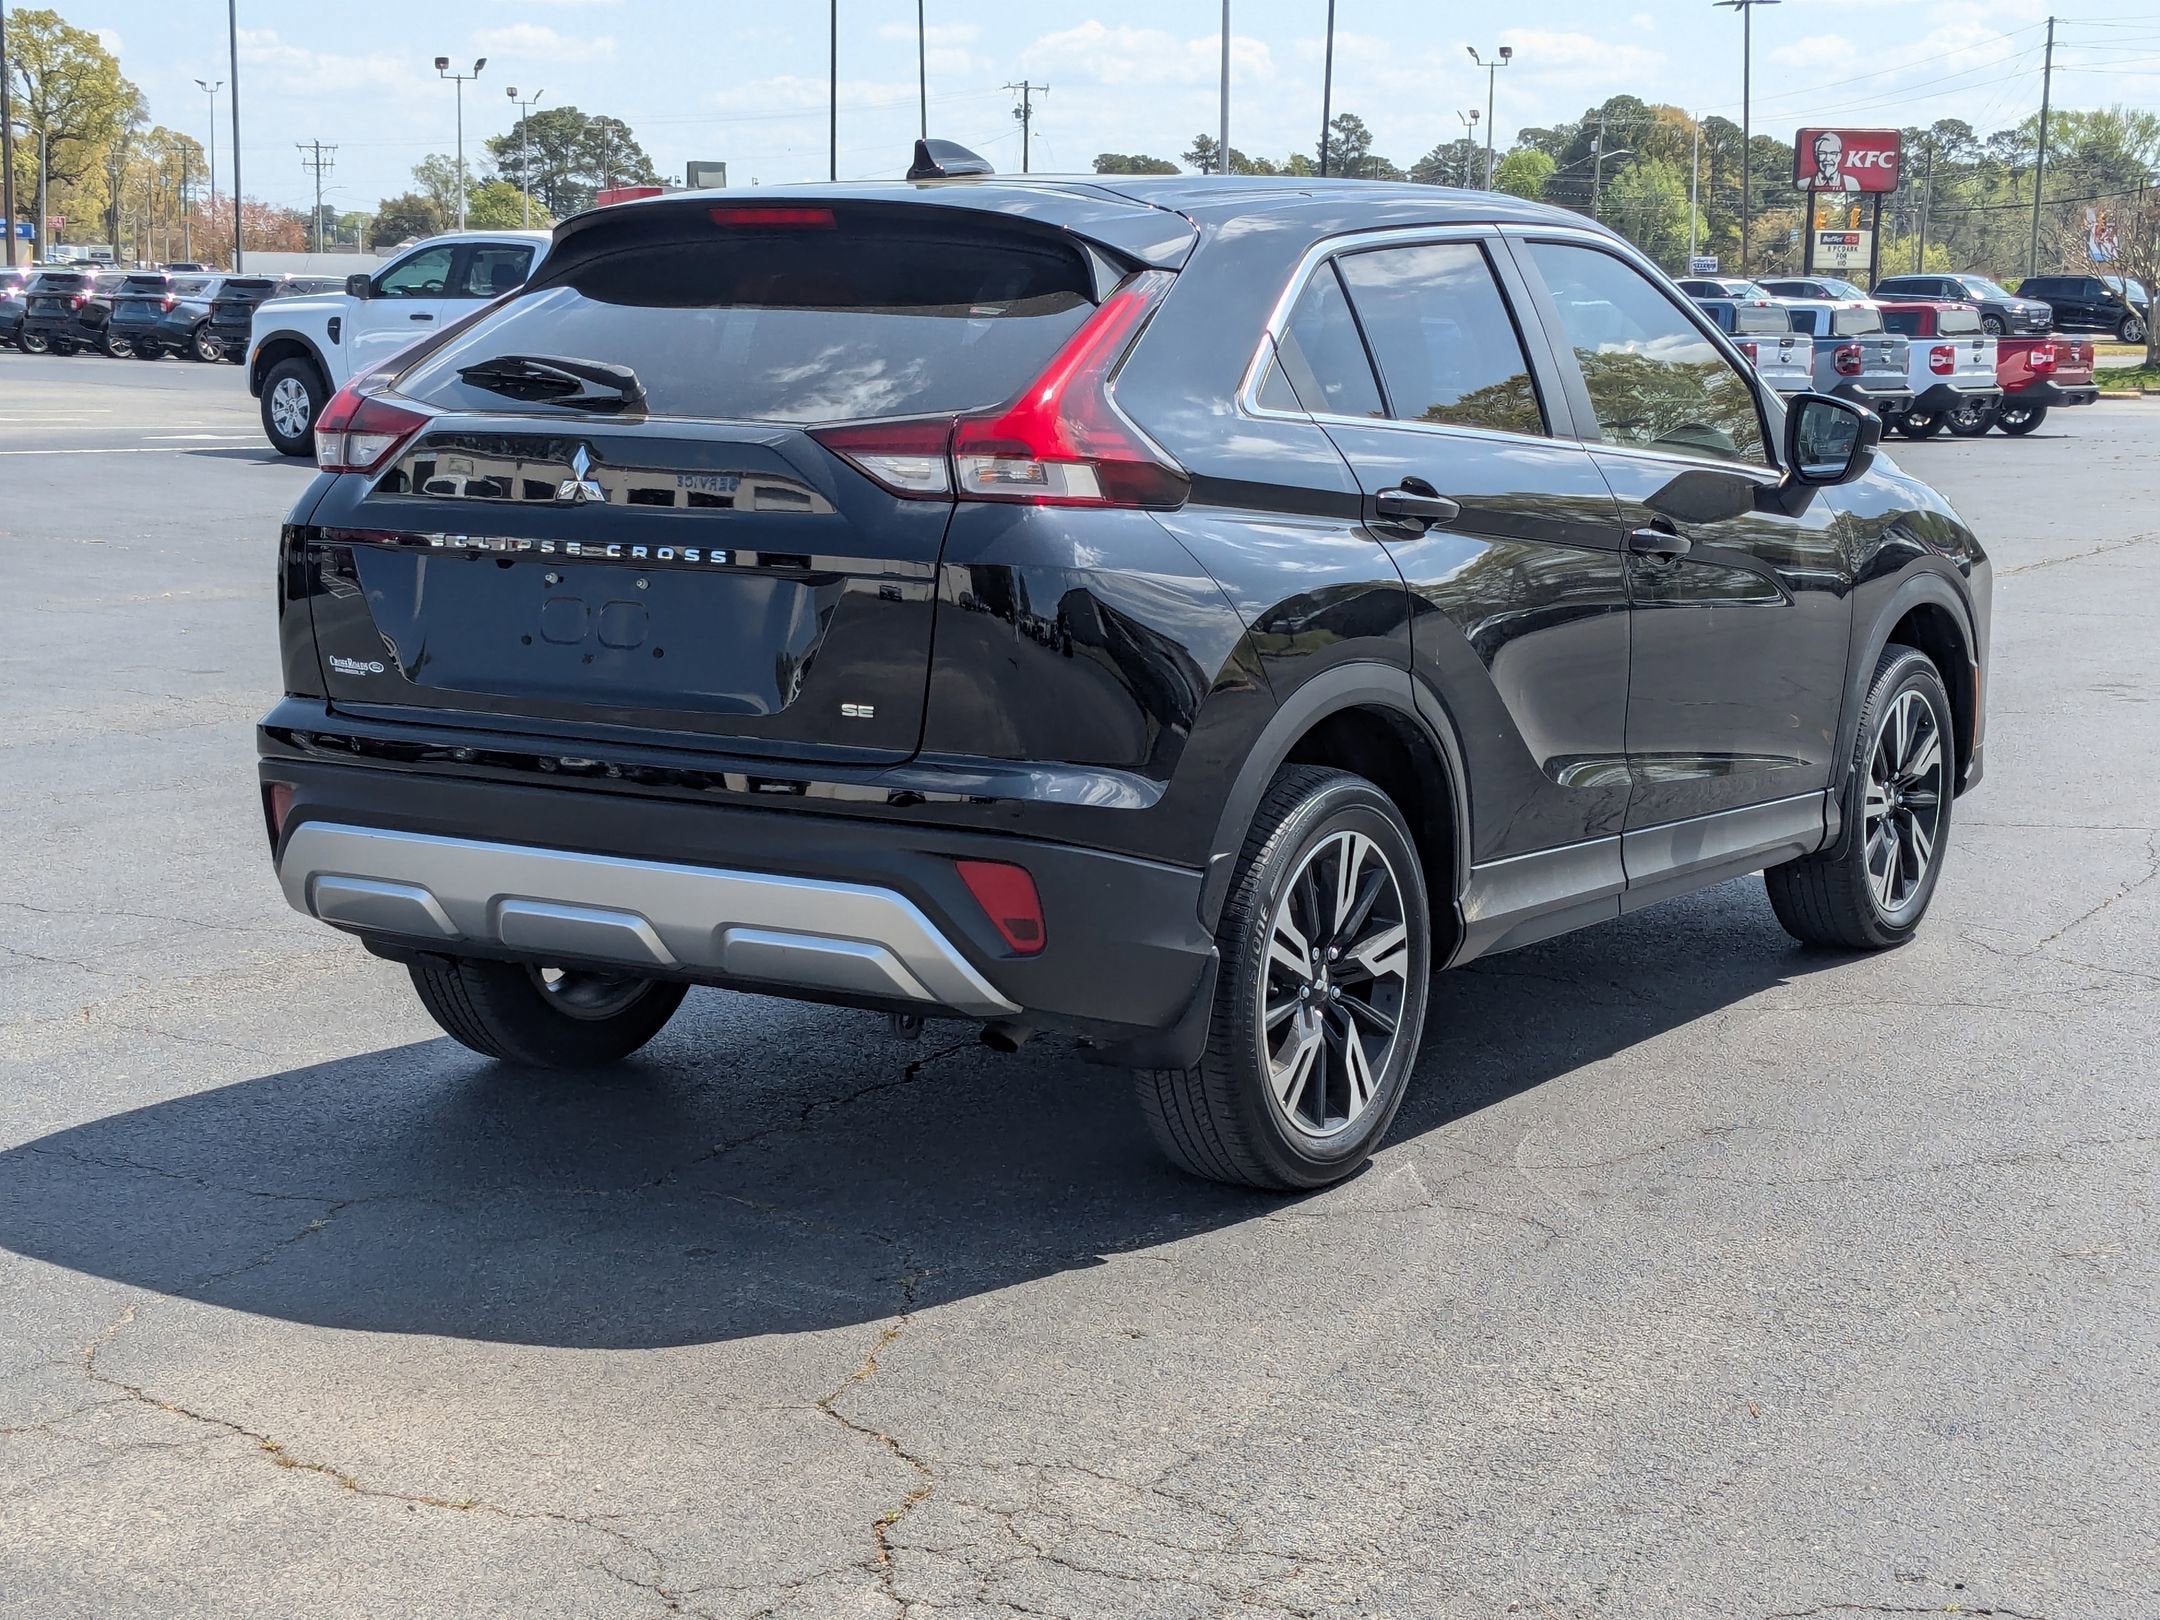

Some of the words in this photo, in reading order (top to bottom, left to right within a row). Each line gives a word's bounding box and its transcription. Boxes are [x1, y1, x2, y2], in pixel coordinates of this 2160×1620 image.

[1844, 150, 1896, 168] KFC
[431, 533, 581, 556] ECLIPSE
[606, 544, 727, 563] CROSS
[841, 703, 874, 718] SE
